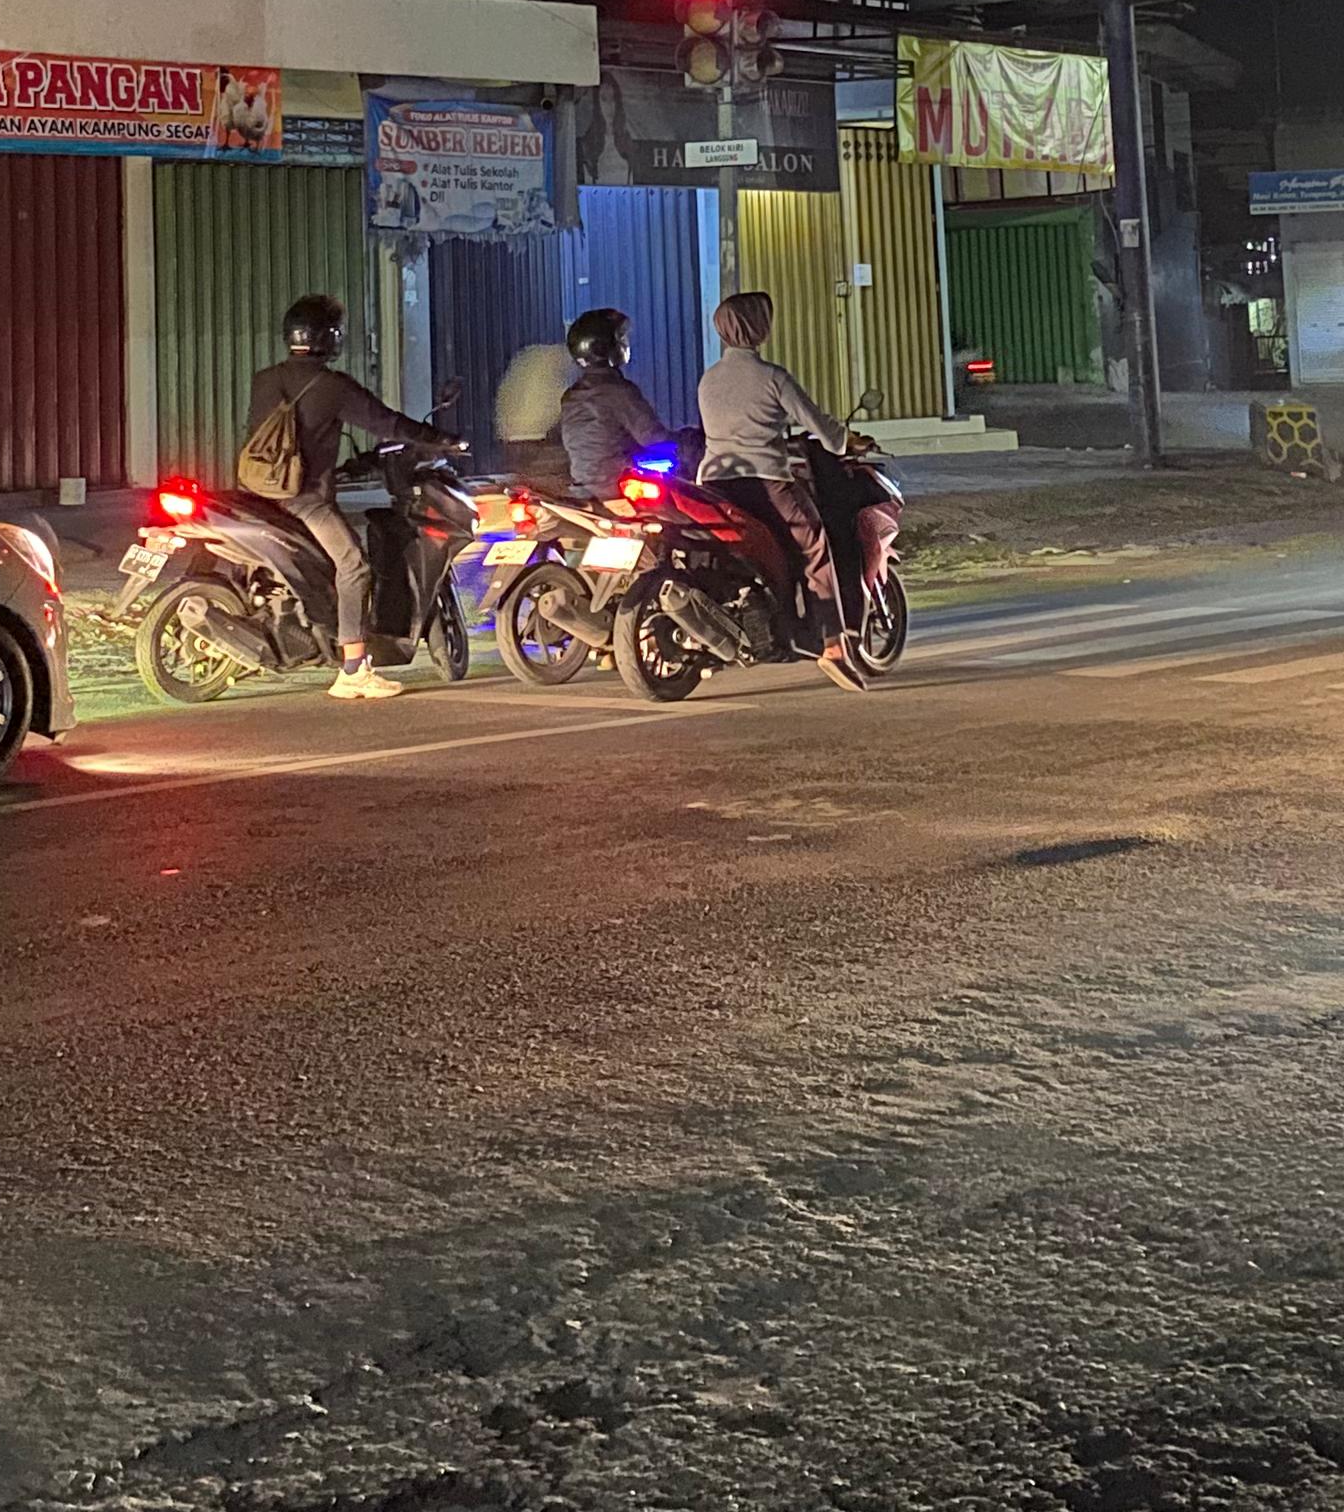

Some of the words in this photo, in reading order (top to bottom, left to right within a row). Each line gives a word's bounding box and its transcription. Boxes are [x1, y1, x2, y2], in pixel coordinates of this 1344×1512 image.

[13, 58, 204, 114] PANGAN
[27, 119, 74, 136] AYAM
[79, 121, 162, 139] KAMPUNG
[380, 123, 467, 154] SUMBER
[472, 129, 542, 157] REJEKI
[699, 144, 726, 154] BELOK
[431, 164, 451, 175] Alat
[454, 164, 477, 176] Tulis
[480, 166, 519, 177] Sekolah
[430, 179, 451, 189] Alat
[454, 179, 478, 189] Tulis
[481, 180, 514, 191] Kantor
